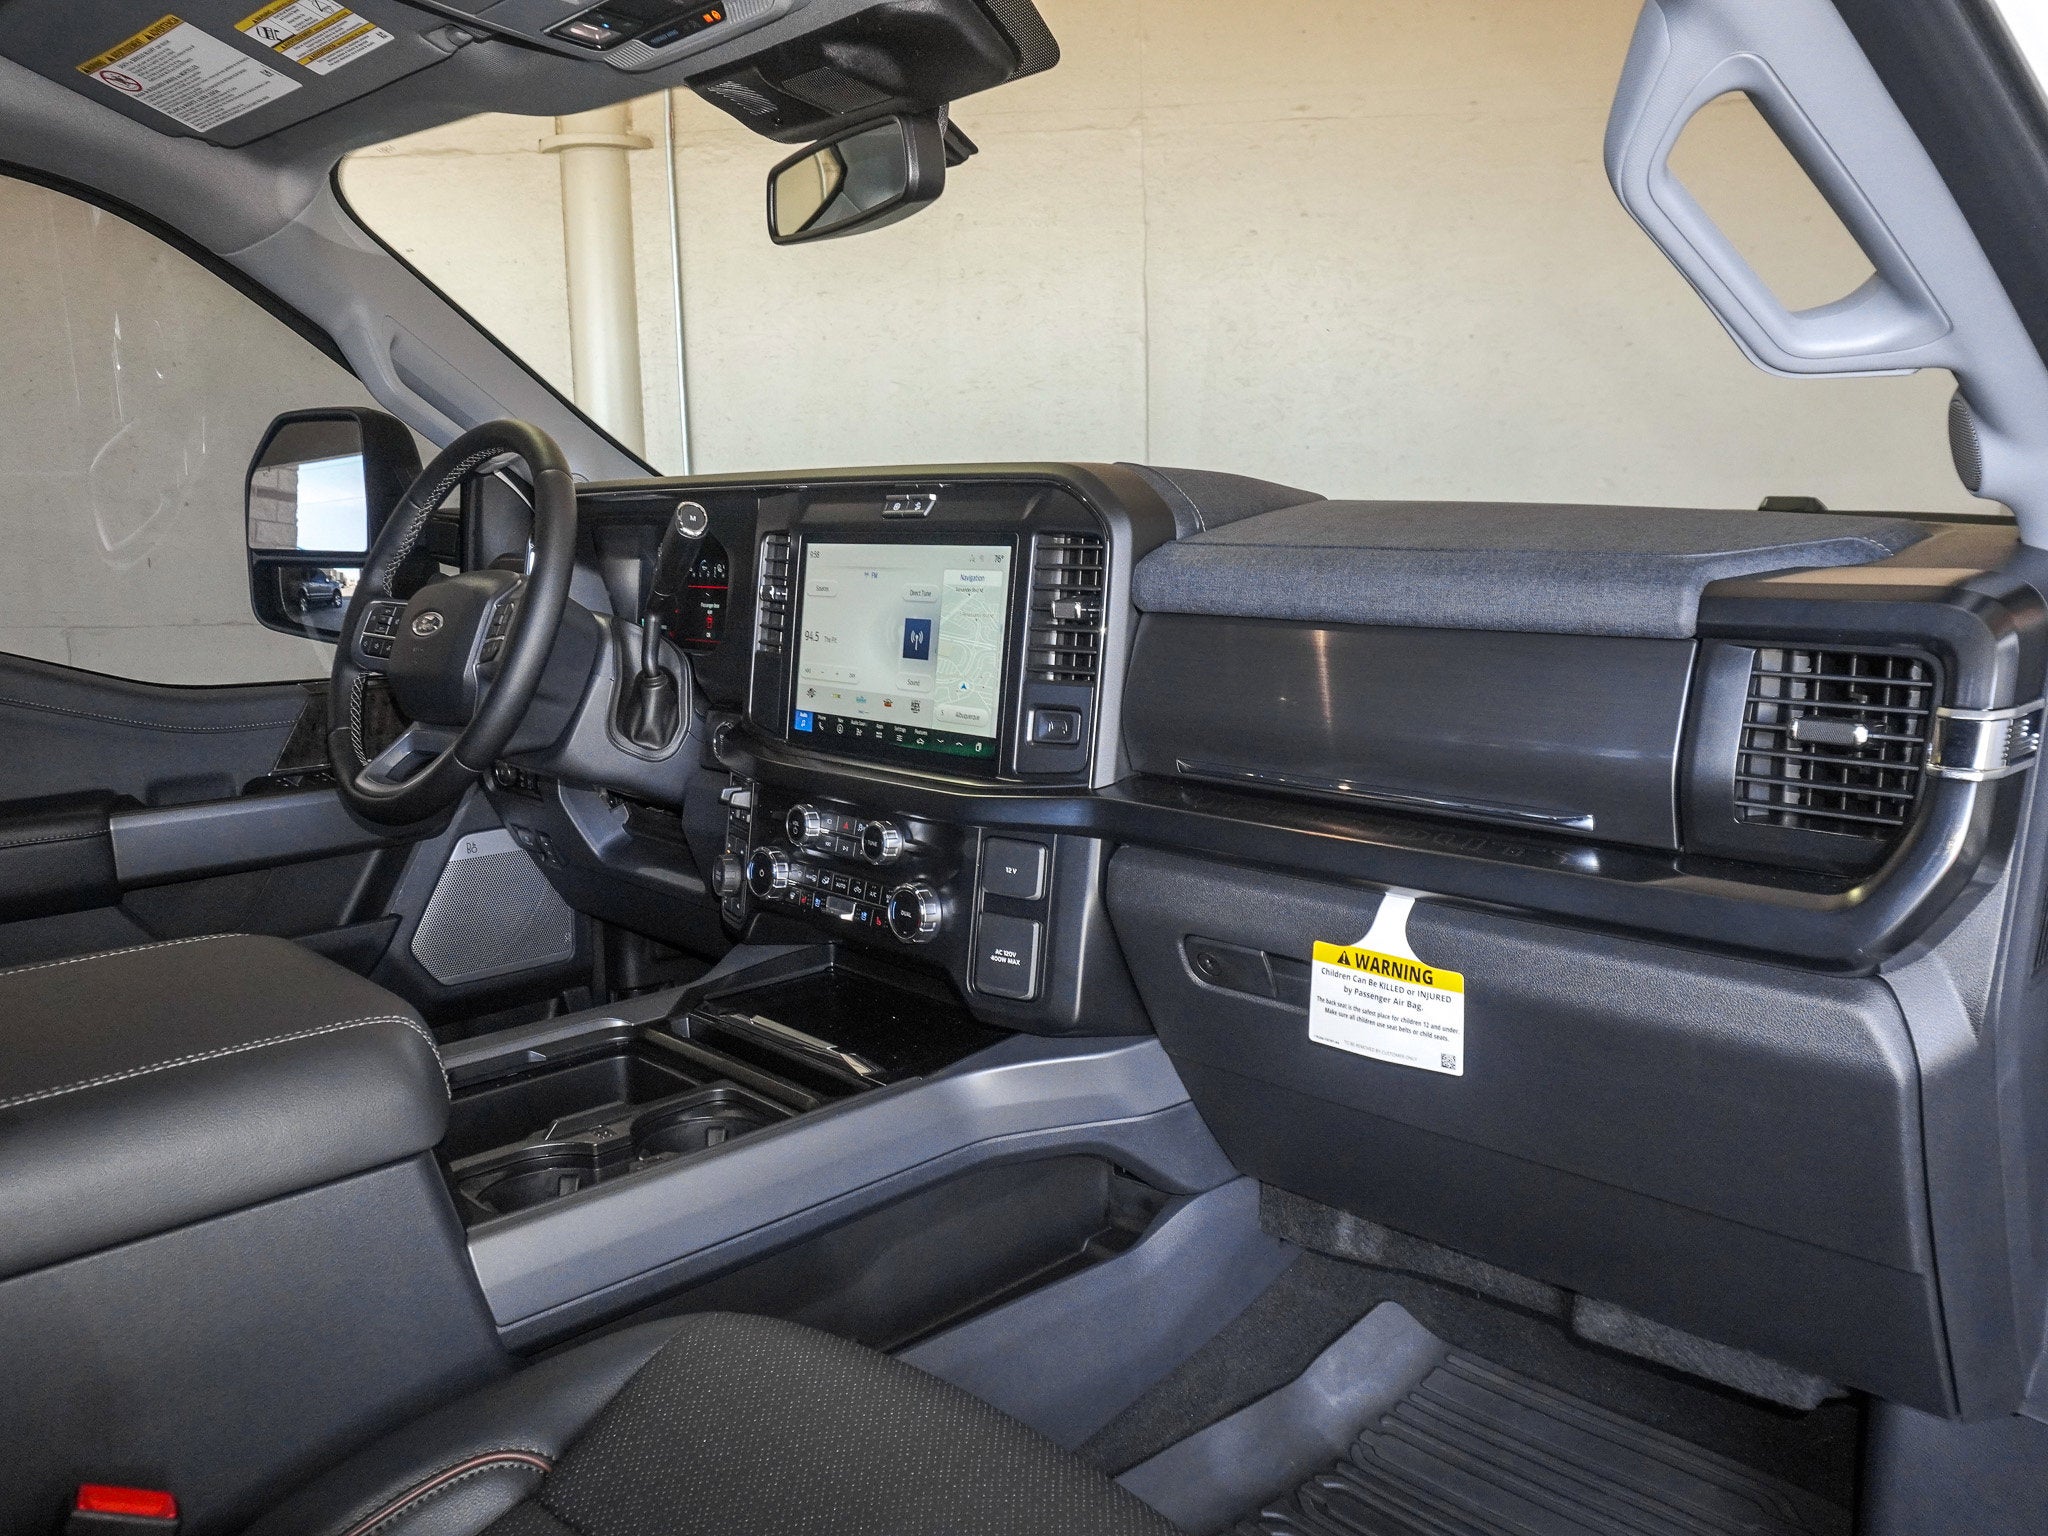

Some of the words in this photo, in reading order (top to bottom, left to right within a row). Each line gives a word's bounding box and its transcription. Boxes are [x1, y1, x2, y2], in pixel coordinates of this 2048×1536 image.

[689, 514, 697, 522] M
[960, 574, 985, 582] Navigation
[804, 630, 820, 642] 94.5
[906, 679, 920, 687] Sound
[1003, 950, 1016, 958] 120V
[990, 955, 1006, 964] 400W
[1007, 958, 1020, 966] MAX
[1355, 953, 1433, 985] WARNING
[1321, 967, 1350, 980] Children
[1353, 975, 1366, 985] Can
[1369, 978, 1377, 987] Be
[1379, 981, 1404, 993] KILLED
[1407, 988, 1415, 996] or
[1417, 990, 1451, 1003] INJURED
[1344, 985, 1352, 995] by
[1354, 988, 1390, 1005] Passenger
[1393, 996, 1404, 1006] Air
[1407, 1000, 1423, 1012] Bag.
[1326, 998, 1336, 1007] back
[1337, 1001, 1347, 1009] seat
[1362, 1007, 1376, 1017] safest
[1377, 1011, 1390, 1021] place
[1400, 1016, 1421, 1027] children
[1431, 1023, 1441, 1031] and
[1442, 1025, 1460, 1035] under.
[1324, 1007, 1337, 1016] Make
[1339, 1011, 1348, 1019] sure
[1356, 1015, 1376, 1026] children
[1377, 1021, 1386, 1029] use
[1386, 1023, 1397, 1031] seat
[1399, 1025, 1411, 1034] belts
[1420, 1030, 1432, 1038] child
[1434, 1033, 1449, 1042] seats.
